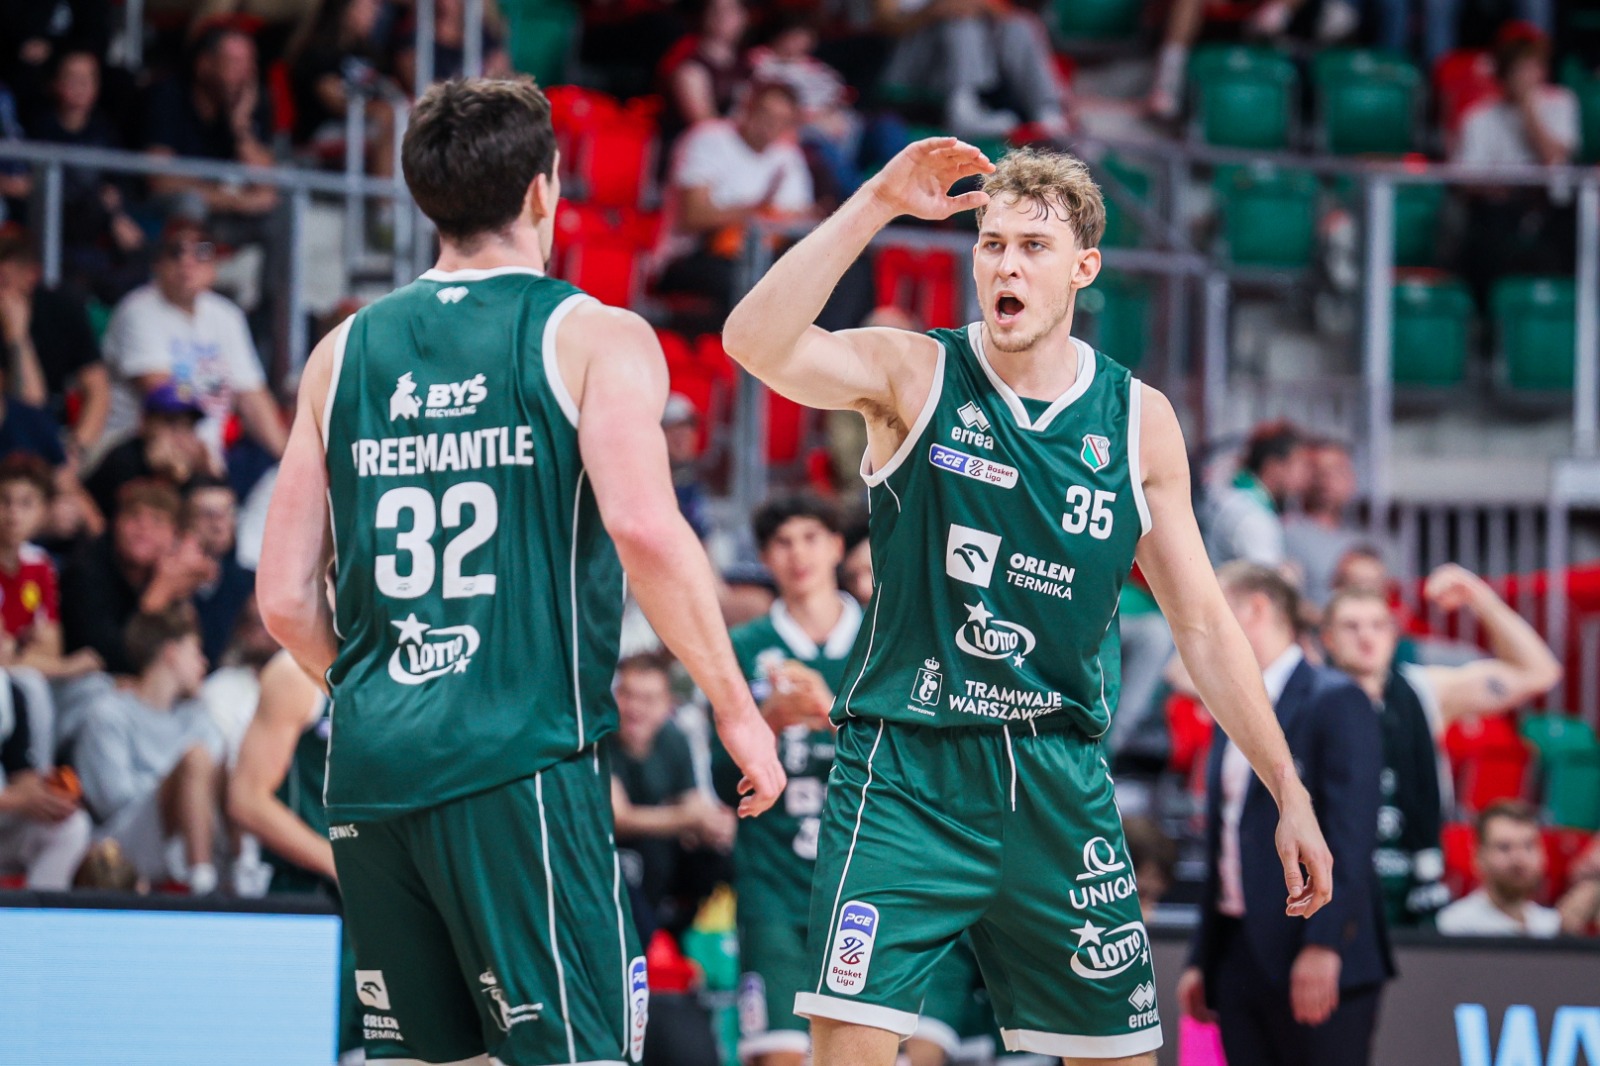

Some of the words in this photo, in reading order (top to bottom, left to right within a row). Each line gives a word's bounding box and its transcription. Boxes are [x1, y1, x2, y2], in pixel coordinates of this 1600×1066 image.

[425, 405, 477, 418] RECYKLING
[951, 427, 994, 449] errea
[933, 452, 964, 468] PGE
[987, 464, 1014, 478] Basket
[985, 472, 1002, 482] Liga
[1061, 485, 1117, 540] 35
[375, 482, 498, 599] 32
[1009, 552, 1076, 583] ORLEN
[1006, 570, 1072, 600] TERMIKA
[973, 625, 1019, 652] LOTTO
[407, 636, 463, 673] LOTTO
[965, 680, 1062, 709] TRAMWAJE
[1069, 873, 1138, 909] UNIQA
[844, 913, 873, 927] PGE
[1086, 930, 1141, 969] LOTTO
[832, 966, 862, 979] Basket
[836, 975, 854, 987] Liga
[1128, 1008, 1159, 1029] errea
